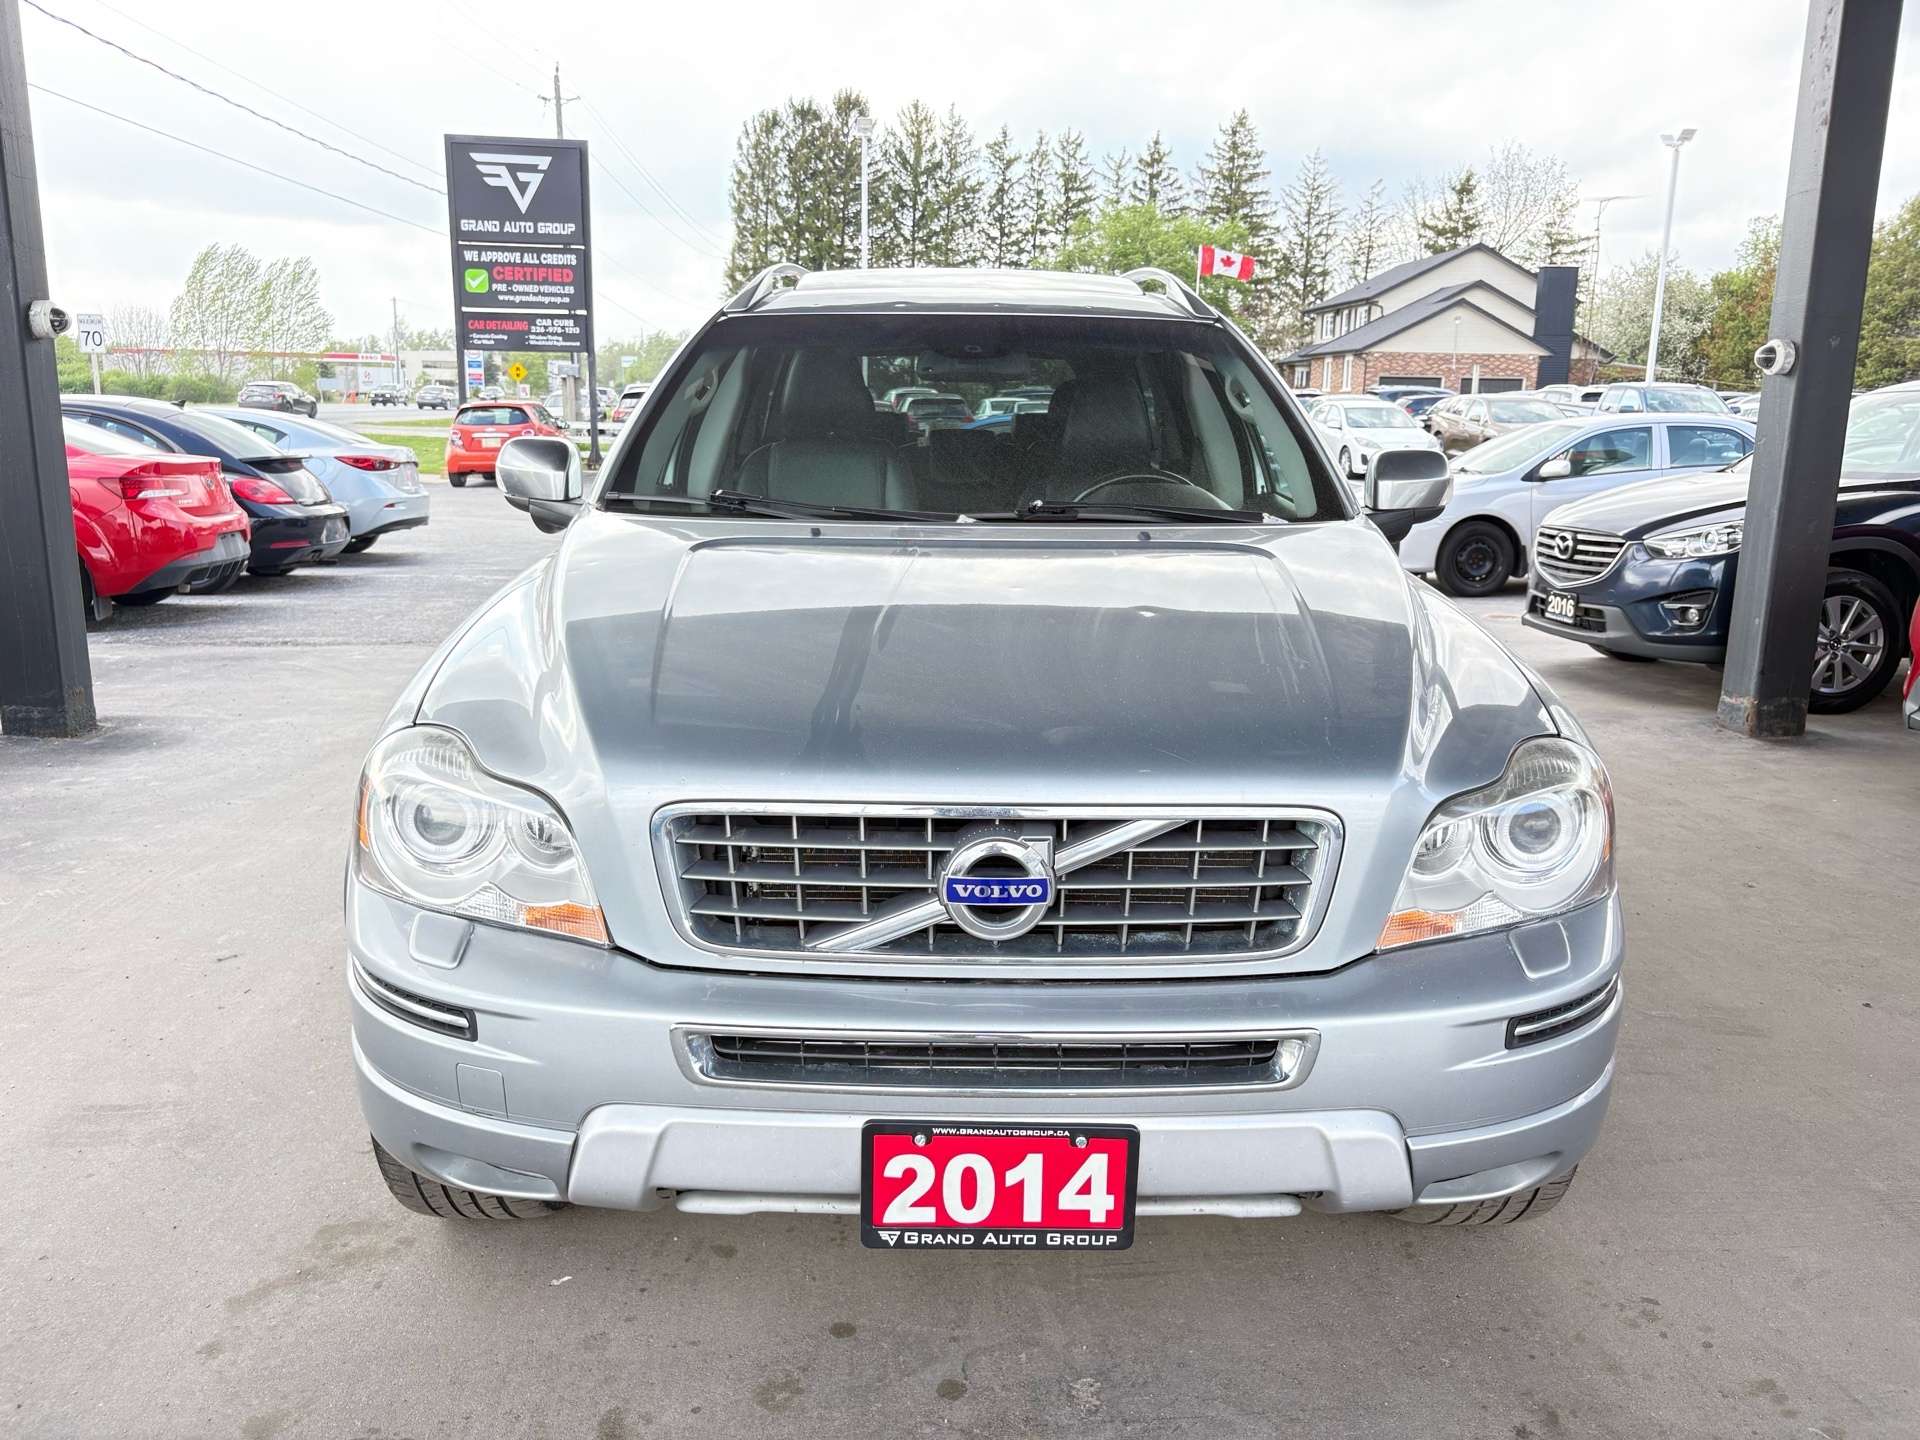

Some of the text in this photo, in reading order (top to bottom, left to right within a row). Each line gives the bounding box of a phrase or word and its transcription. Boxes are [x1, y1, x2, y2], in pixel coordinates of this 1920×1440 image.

[460, 219, 576, 235] GRAND AUTO GROUP
[464, 250, 577, 265] WE APPROVE ALL CREDITS
[492, 265, 574, 283] CERTIFIED
[492, 283, 508, 292] PRE
[539, 285, 575, 294] VEHICLES
[468, 319, 529, 331] CAR DETAILING
[80, 330, 103, 347] 70
[1547, 594, 1575, 617] 2016
[952, 884, 1043, 898] VOLVO
[932, 1127, 1070, 1137] WWW.GRANDAUTOGROUP.CA
[882, 1152, 1115, 1224] 2014
[904, 1231, 1118, 1246] GRAND AUTO GROUP
